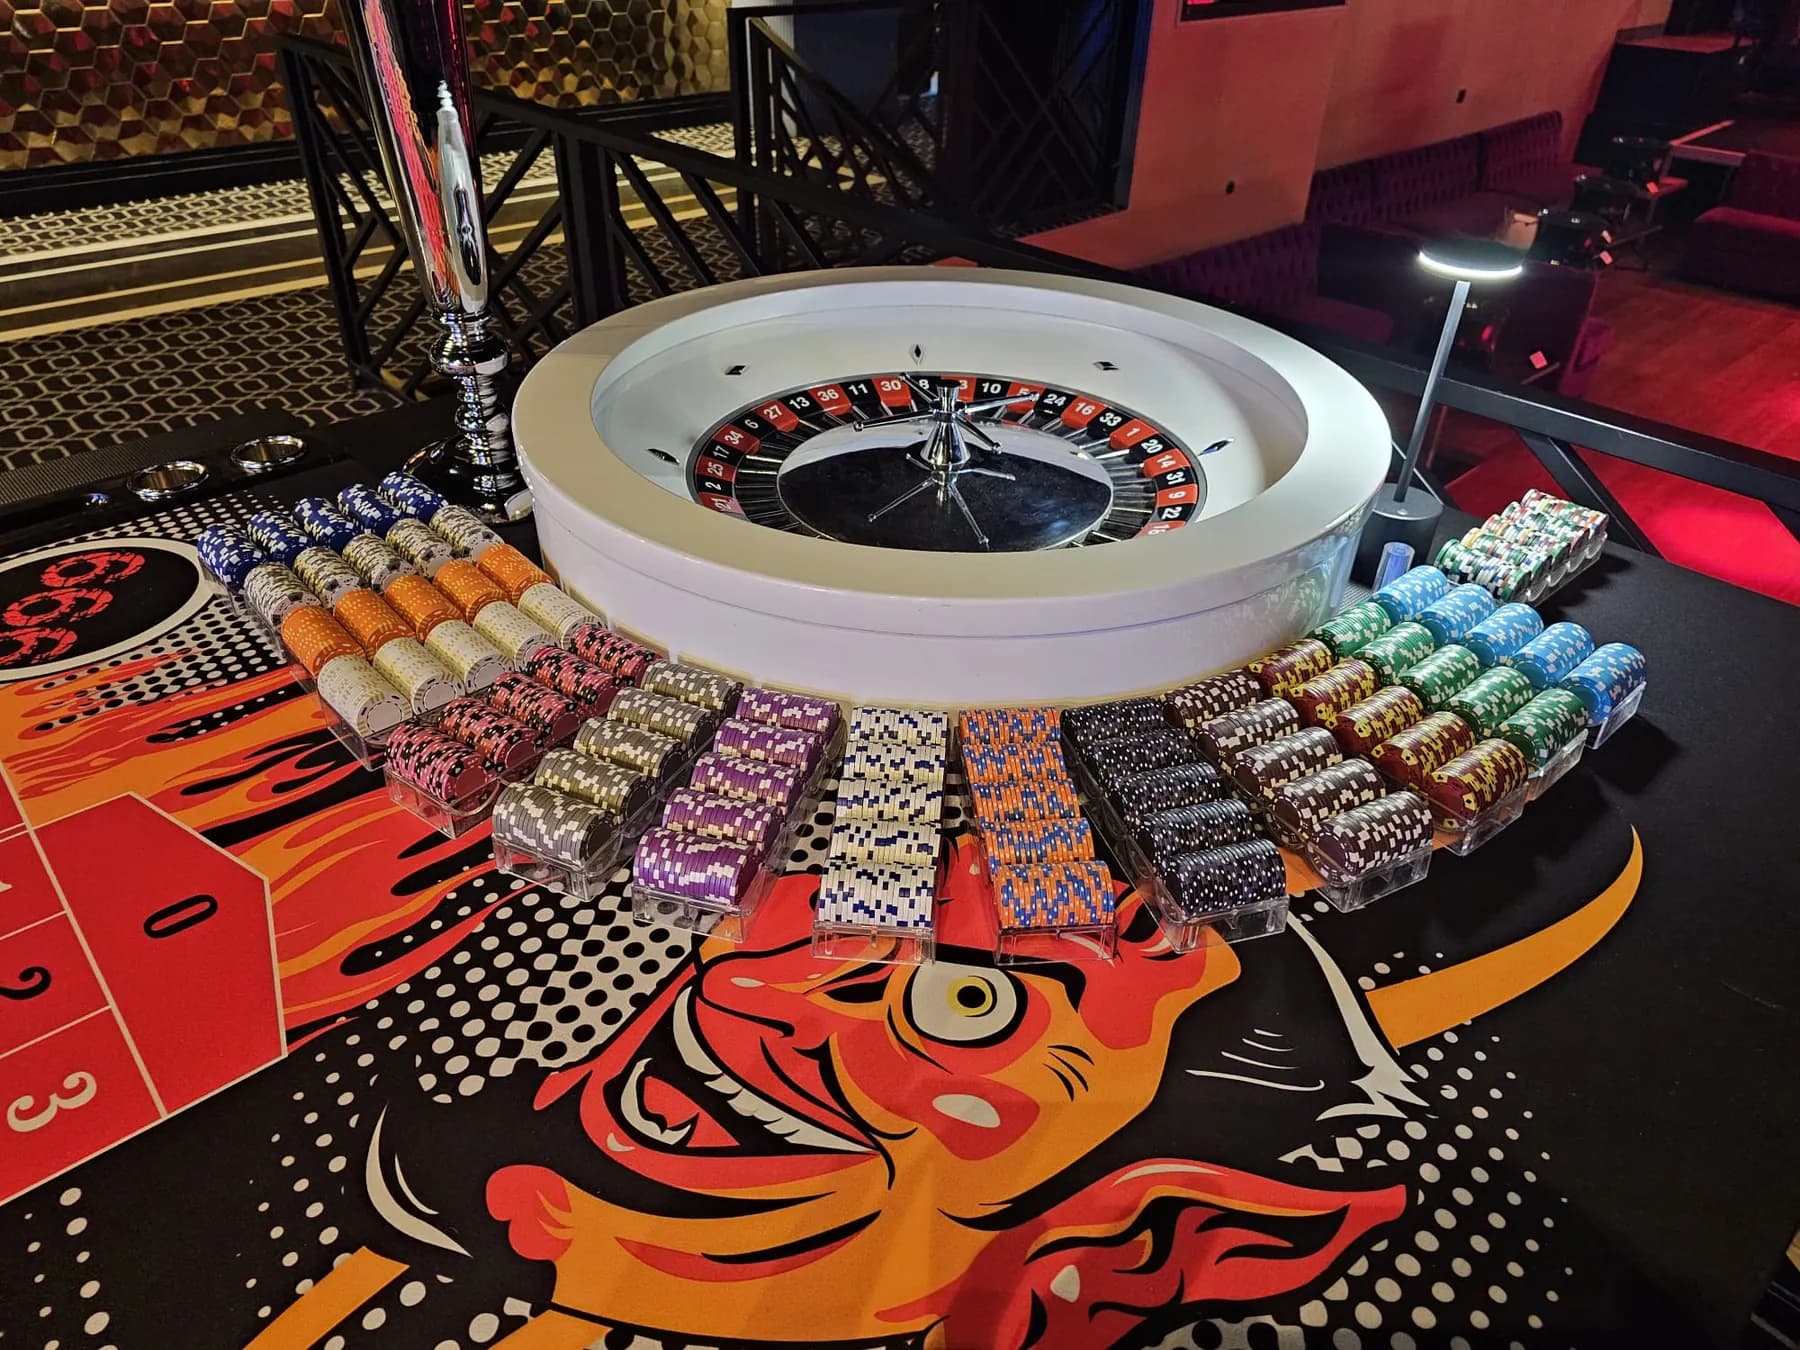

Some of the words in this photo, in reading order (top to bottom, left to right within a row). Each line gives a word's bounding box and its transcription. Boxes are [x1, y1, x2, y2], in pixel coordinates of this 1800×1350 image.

[848, 383, 869, 396] 11
[880, 379, 902, 392] 30
[918, 378, 930, 390] 8
[981, 382, 1002, 394] 10
[817, 388, 840, 402] 36
[1043, 393, 1067, 407] 24
[789, 396, 810, 410] 13
[1075, 402, 1096, 415] 16
[763, 404, 783, 420] 27
[744, 418, 759, 430] 6
[1099, 412, 1122, 427] 33
[724, 430, 745, 445] 34
[1126, 427, 1140, 437] 1
[712, 445, 730, 459] 17
[1140, 438, 1164, 454] 20
[1156, 454, 1177, 469] 14
[706, 461, 724, 477] 25
[1166, 471, 1186, 485] 31
[704, 481, 722, 491] 2
[1168, 490, 1187, 500] 9
[1161, 505, 1183, 521] 22
[143, 894, 218, 939] 0
[6, 1071, 98, 1133] 3
